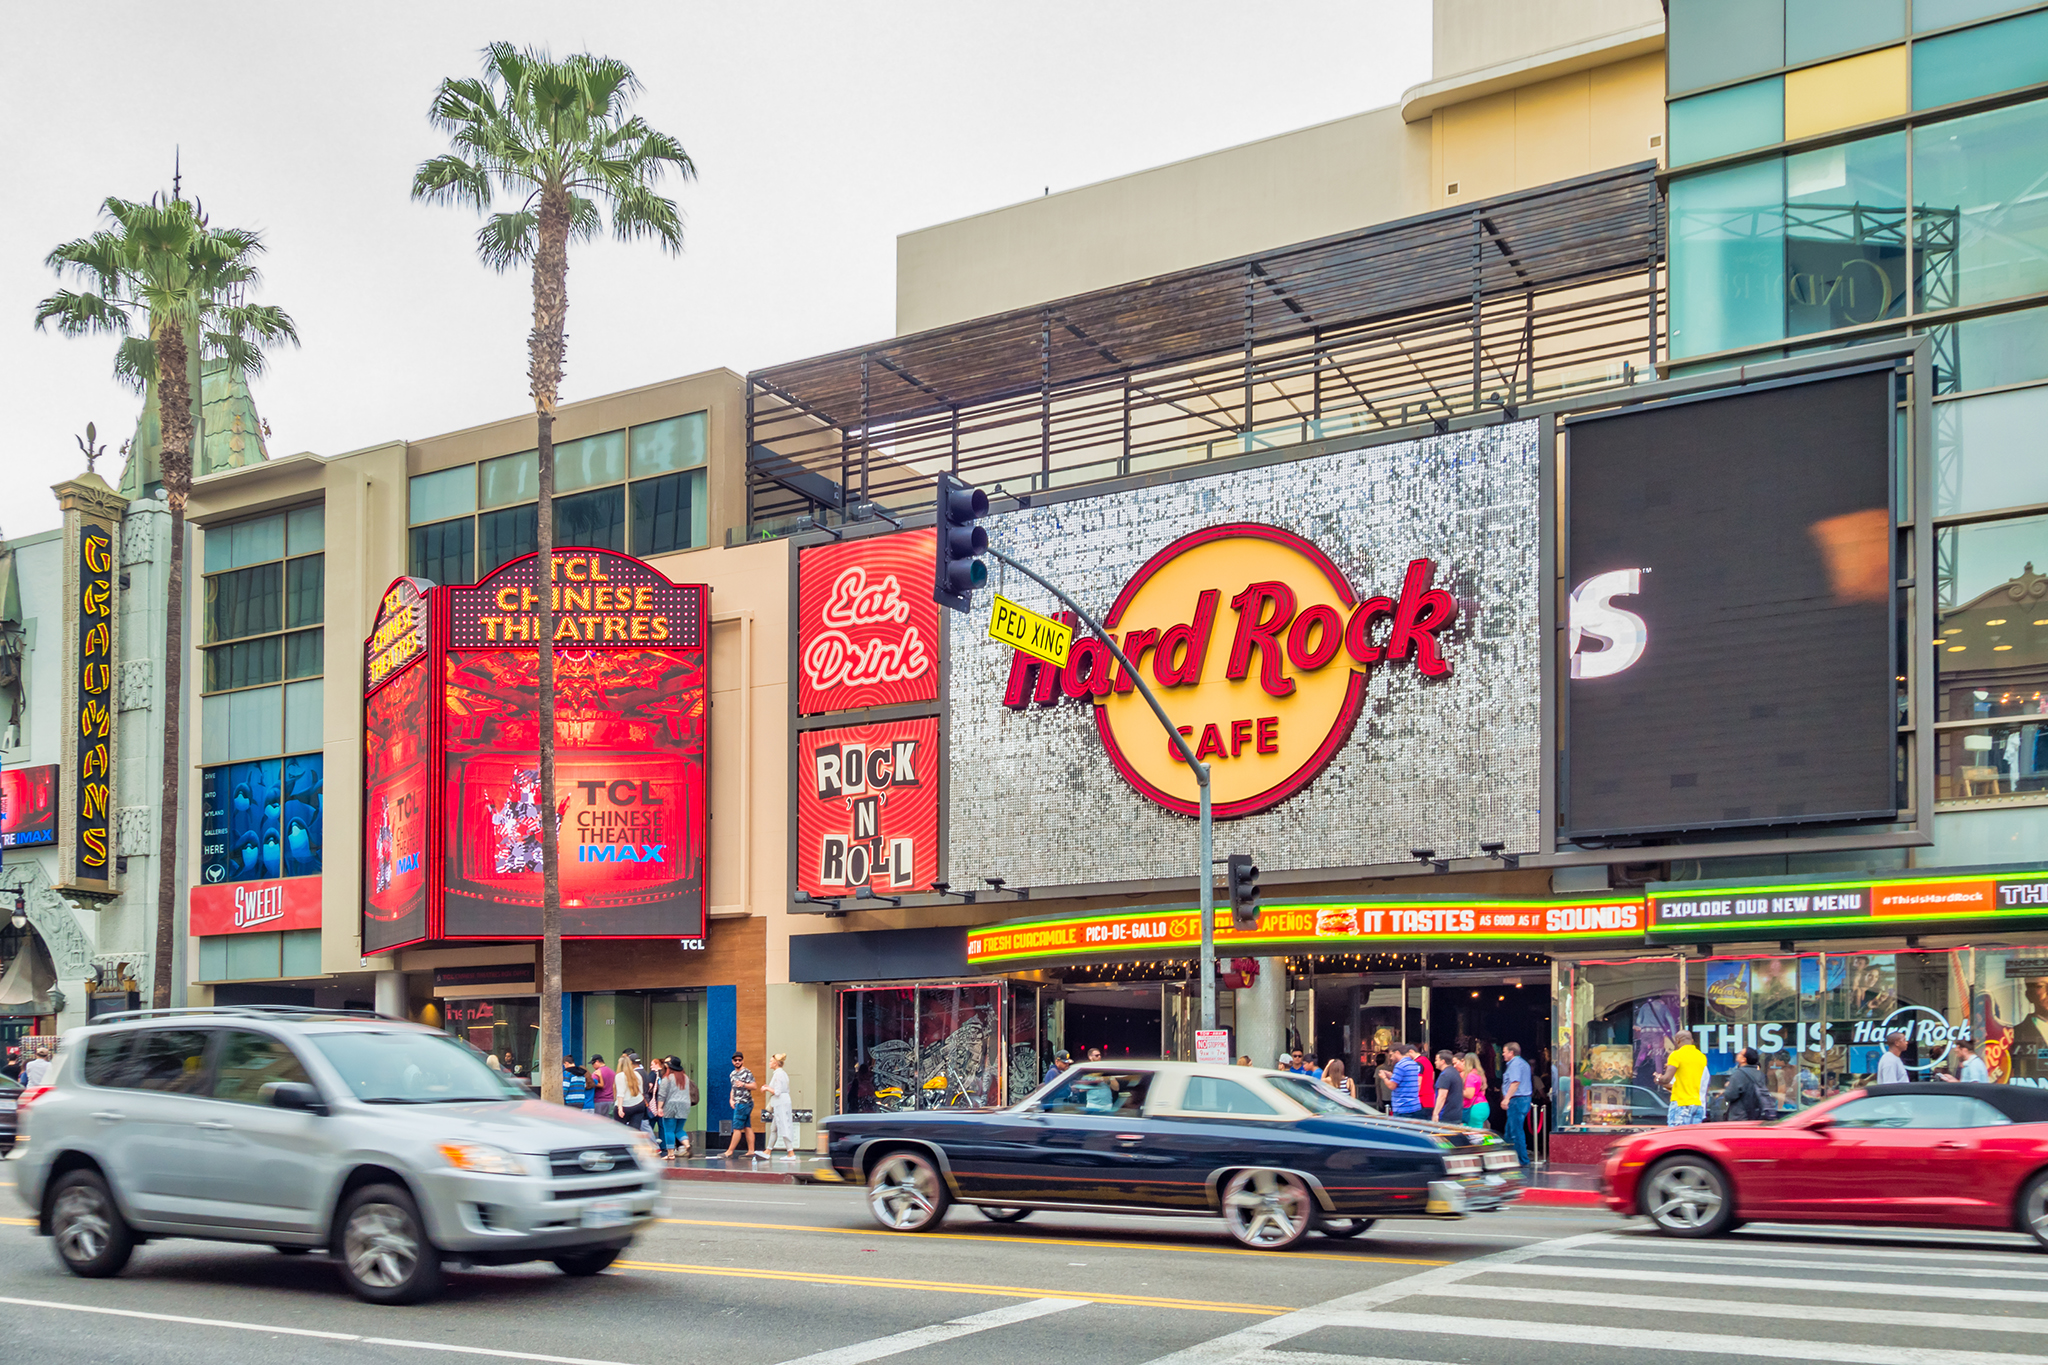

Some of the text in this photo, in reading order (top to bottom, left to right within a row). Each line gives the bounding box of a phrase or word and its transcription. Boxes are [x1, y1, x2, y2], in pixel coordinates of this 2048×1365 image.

[551, 557, 608, 582] TCL
[385, 586, 401, 617] TCL
[496, 587, 653, 611] CHINESE
[374, 604, 413, 652] CHINESE
[996, 606, 1064, 656] PED XING
[1003, 557, 1458, 710] Hard Rock
[370, 630, 416, 682] THEATRES
[804, 626, 929, 690] Drink
[82, 535, 110, 866] GRAUMANS
[1167, 716, 1279, 762] CAFE
[815, 741, 919, 798] ROCK
[397, 791, 419, 821] TCL
[577, 780, 663, 806] TCL
[204, 828, 228, 836] GALLERIES
[577, 811, 663, 827] CHINESE
[16, 829, 52, 845] IMAX
[204, 844, 224, 855] HERE
[577, 828, 663, 844] THEATRE
[396, 851, 420, 876] IMAX
[578, 845, 664, 863] IMAX
[822, 836, 912, 888] ROLL
[1364, 905, 1637, 932] IT TASTES AS GOOD AS IT SOUNDS
[1661, 894, 1861, 918] EXPLORE OUR NEW MENU
[681, 939, 705, 951] TCL
[983, 934, 1012, 953] FRESH
[1013, 928, 1077, 949] GUACAMOLE
[1085, 921, 1167, 942] PICO-DE-GALLO
[1197, 1040, 1207, 1049] NO
[1797, 1022, 1834, 1053] IS
[1853, 1019, 1971, 1047] Hard Rock
